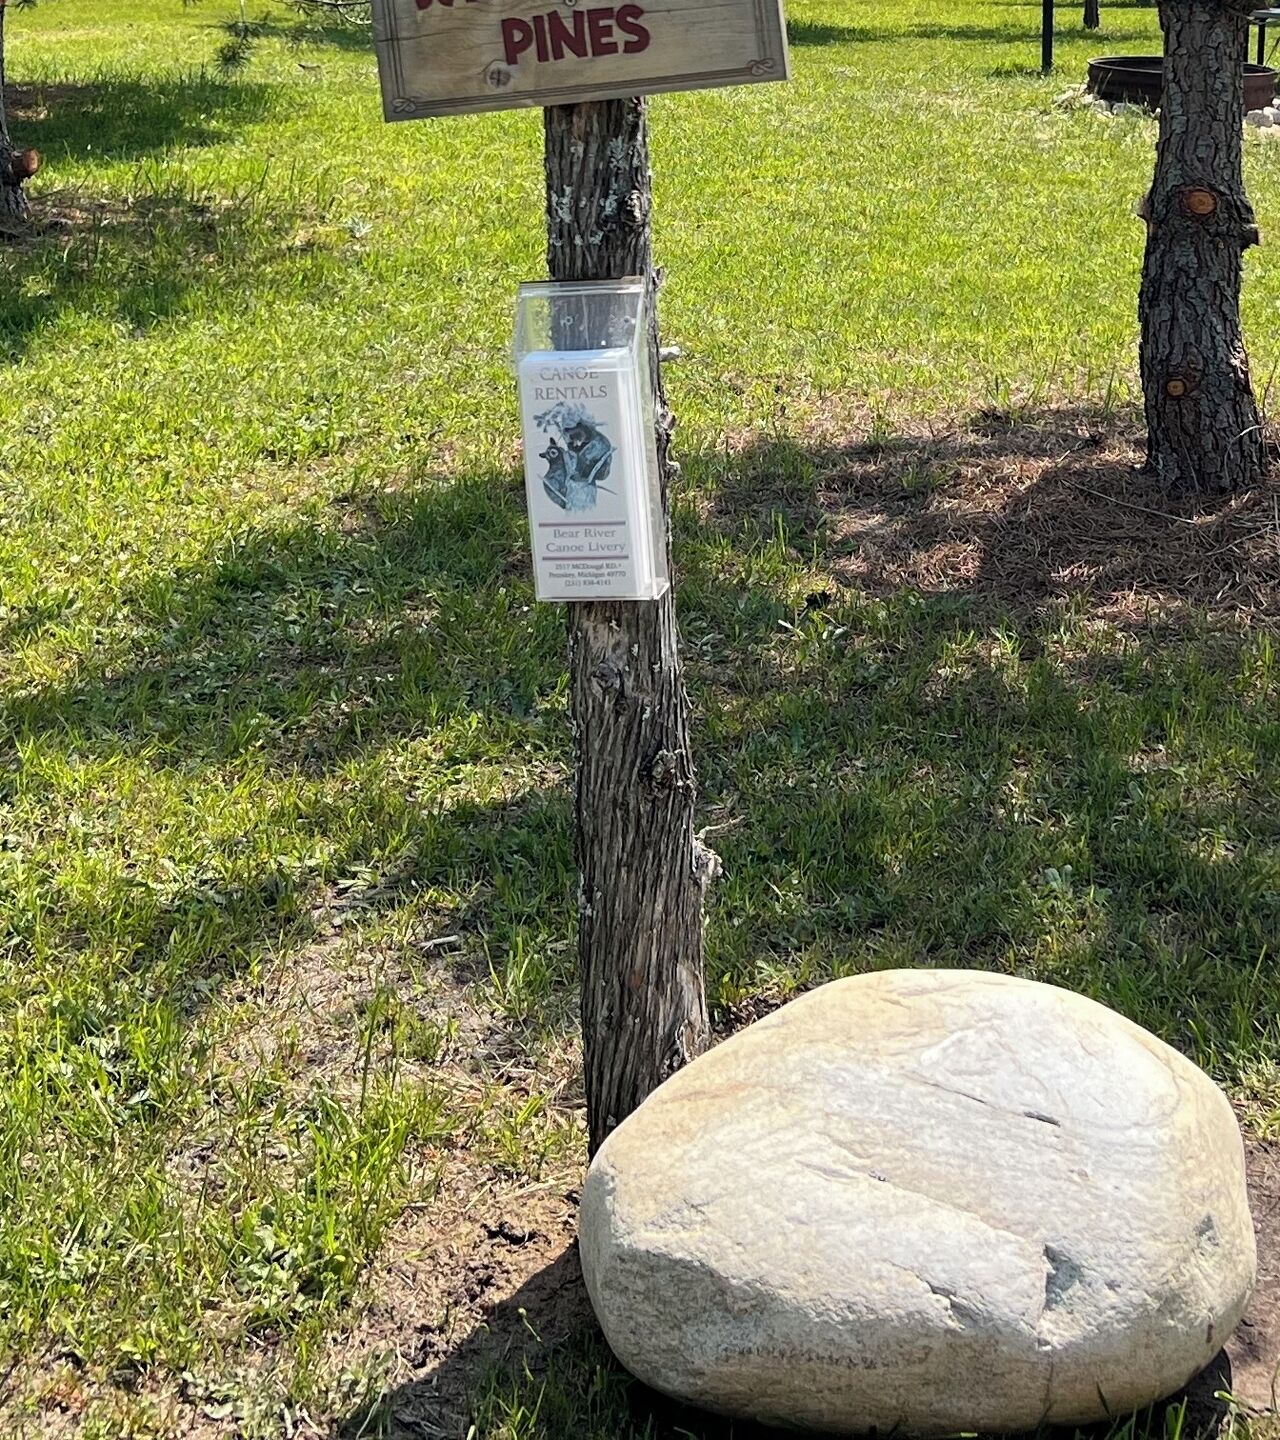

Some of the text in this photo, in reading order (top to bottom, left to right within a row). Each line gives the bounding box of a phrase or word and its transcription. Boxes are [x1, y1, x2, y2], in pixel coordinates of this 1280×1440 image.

[501, 4, 651, 65] PINES
[540, 366, 599, 381] CANOE
[535, 385, 608, 400] RENTALS
[553, 528, 616, 539] Bear River
[546, 541, 626, 553] Canoe Livery
